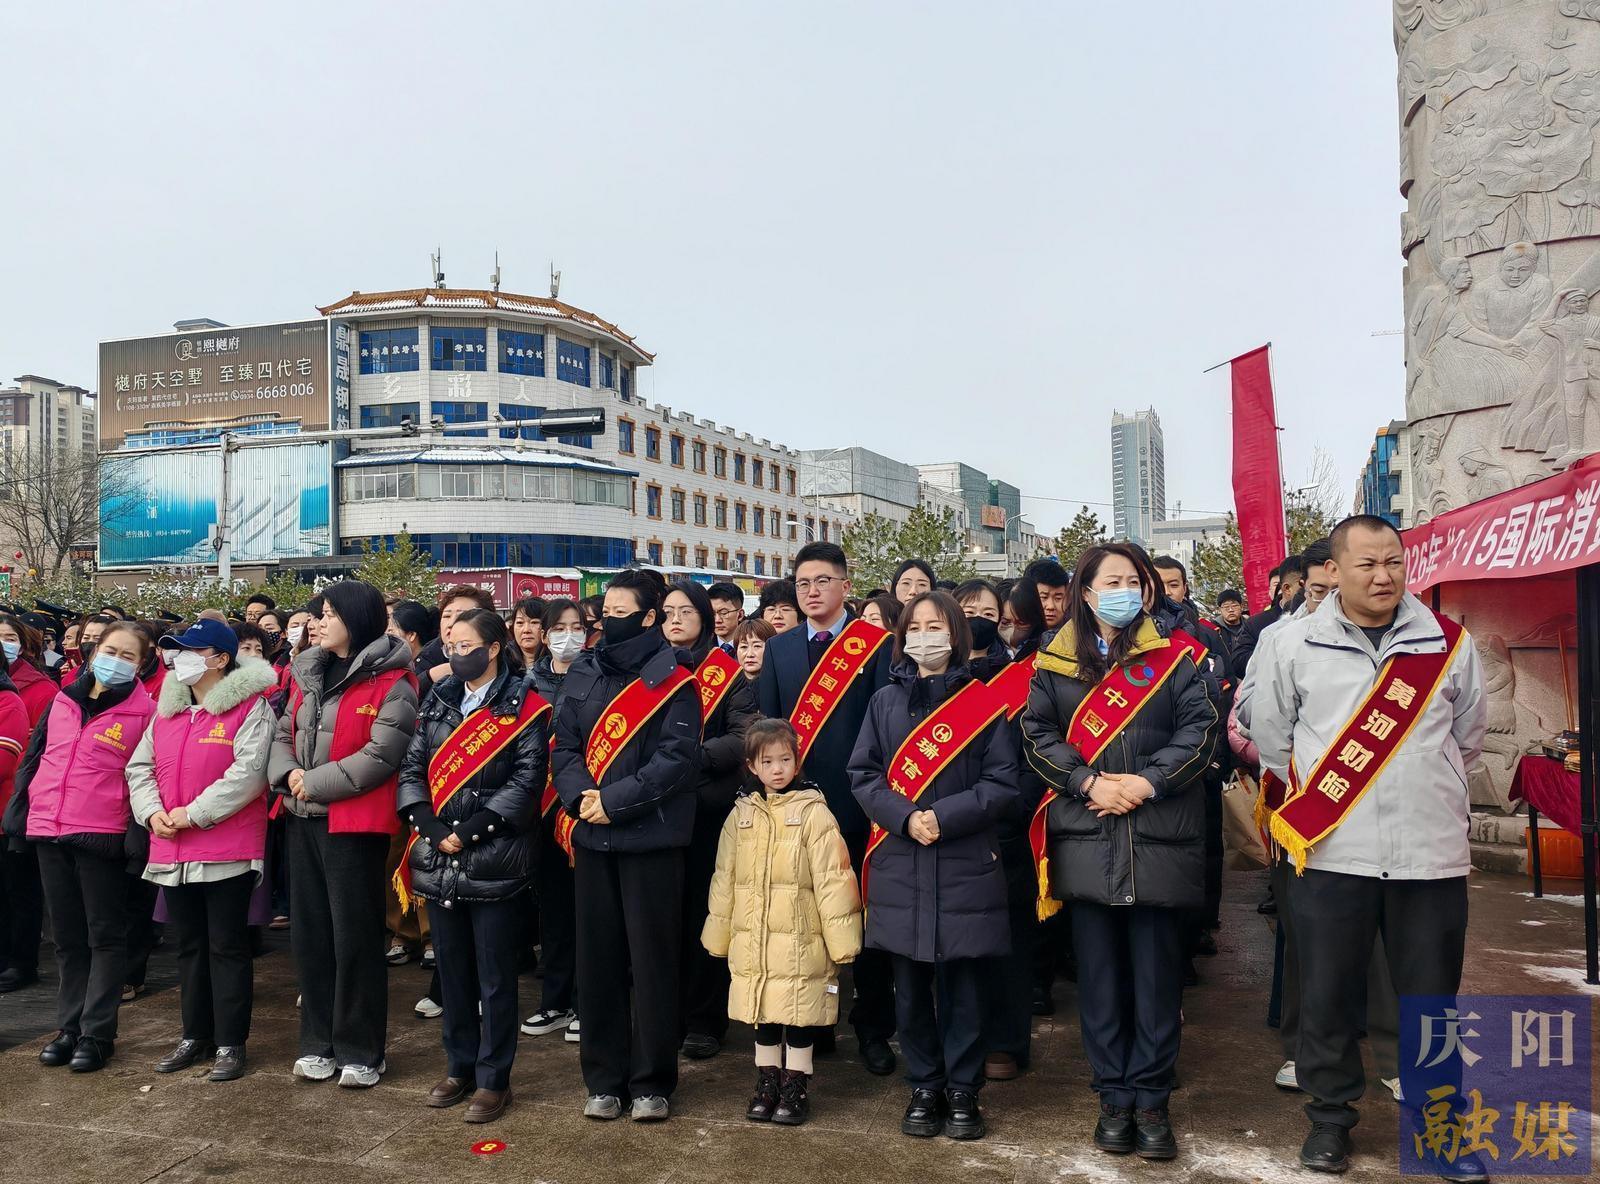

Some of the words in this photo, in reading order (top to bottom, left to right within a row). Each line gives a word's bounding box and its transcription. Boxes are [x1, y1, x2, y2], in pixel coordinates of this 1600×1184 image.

[219, 357, 312, 383] 至臻四代宅
[256, 384, 287, 399] 6668
[290, 382, 314, 397] 006
[1081, 687, 1128, 737] 中国
[1317, 677, 1417, 803] 黄河财险
